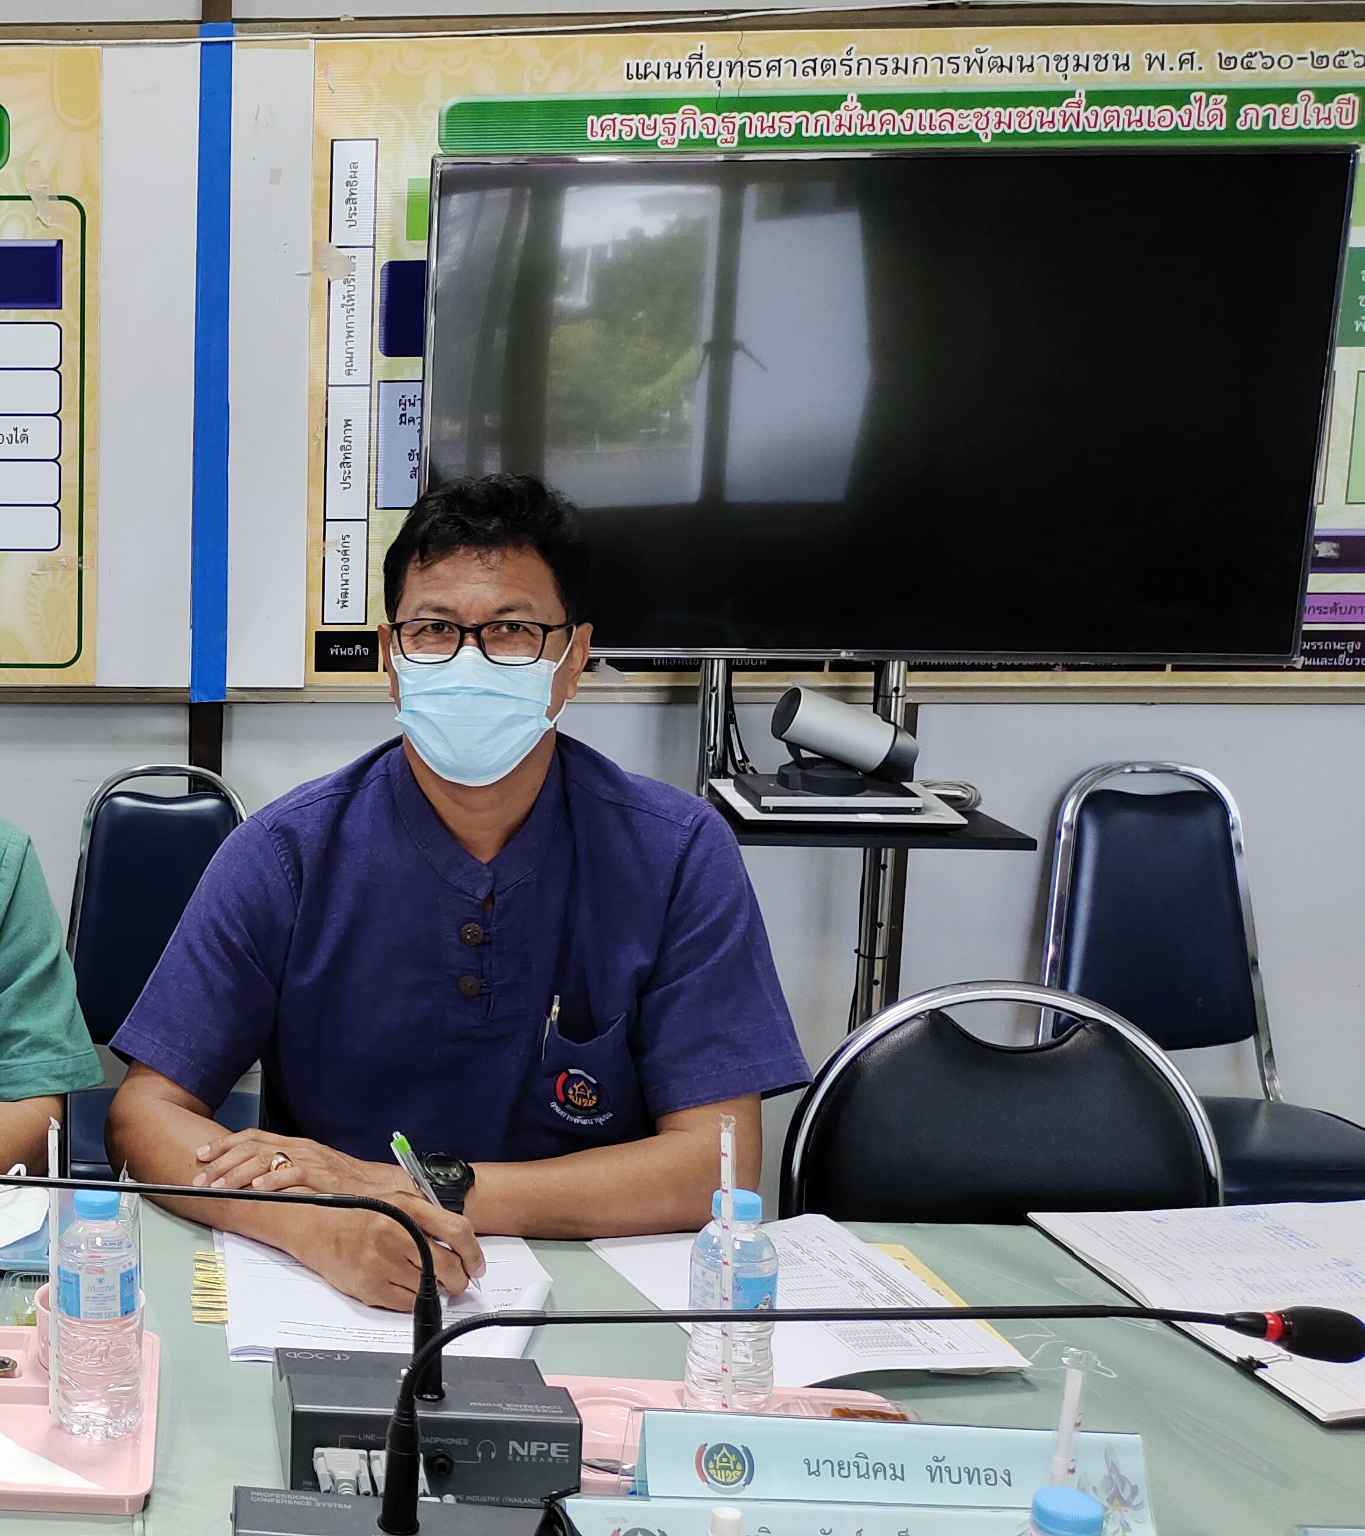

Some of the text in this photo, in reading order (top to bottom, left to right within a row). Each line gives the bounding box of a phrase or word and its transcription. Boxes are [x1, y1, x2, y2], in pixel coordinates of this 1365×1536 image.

[625, 44, 1130, 87] แผนที่ยุทธศาสตร์กรมการพัฒนาชุมชน
[1146, 52, 1203, 72] พ.ศ.
[588, 90, 1357, 146] เศรษฐกิจฐานรากมั่นคงและชุมชนพึ่งตนเองได้ ภายในปี
[344, 161, 360, 229] ประสิทธิผล
[339, 418, 353, 491] ประสิทธิภาพ
[421, 1437, 469, 1446] EADPHONES
[508, 1440, 570, 1458] NPE
[802, 1451, 1014, 1488] นายนิคม ทับทอง
[250, 1490, 317, 1500] PROFESSIONAL
[250, 1497, 352, 1510] CONFERENCE SYSTEM
